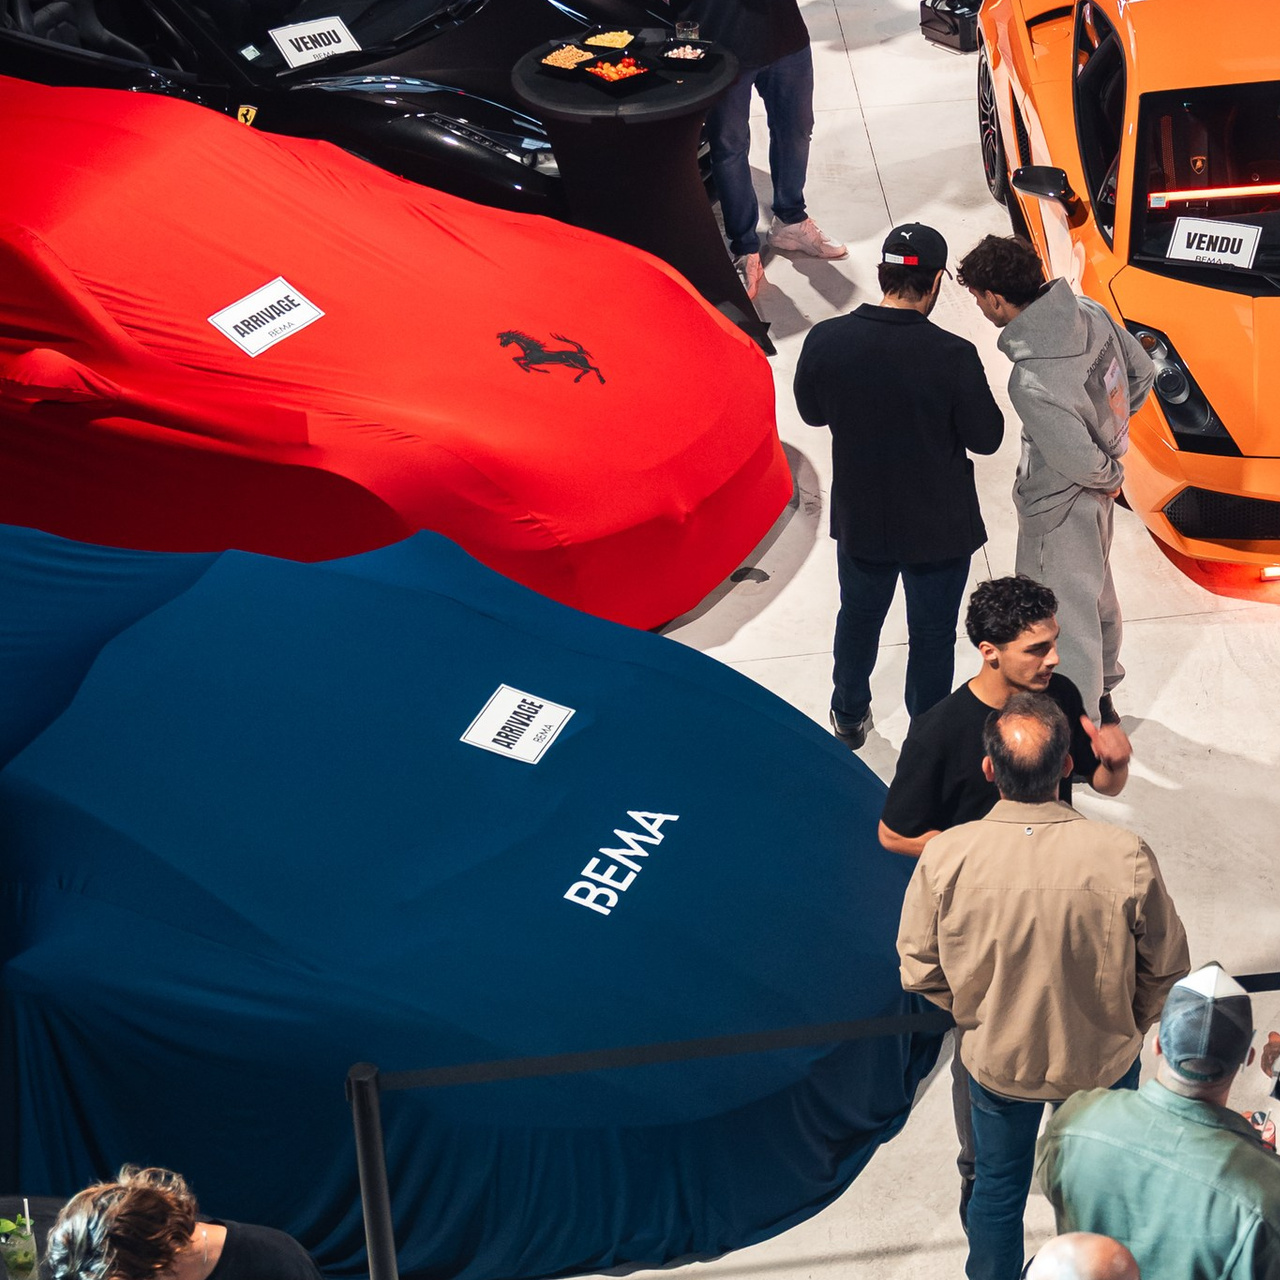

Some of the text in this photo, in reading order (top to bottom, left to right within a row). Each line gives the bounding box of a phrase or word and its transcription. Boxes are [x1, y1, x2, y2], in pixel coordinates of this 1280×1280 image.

[288, 29, 342, 53] VENDU
[1185, 231, 1244, 255] VENDU
[232, 294, 301, 338] ARRIVAGE
[267, 321, 296, 338] BEMA
[491, 698, 544, 750] ARRIVAGE
[532, 724, 555, 744] BEMA
[563, 810, 680, 916] BEMA
